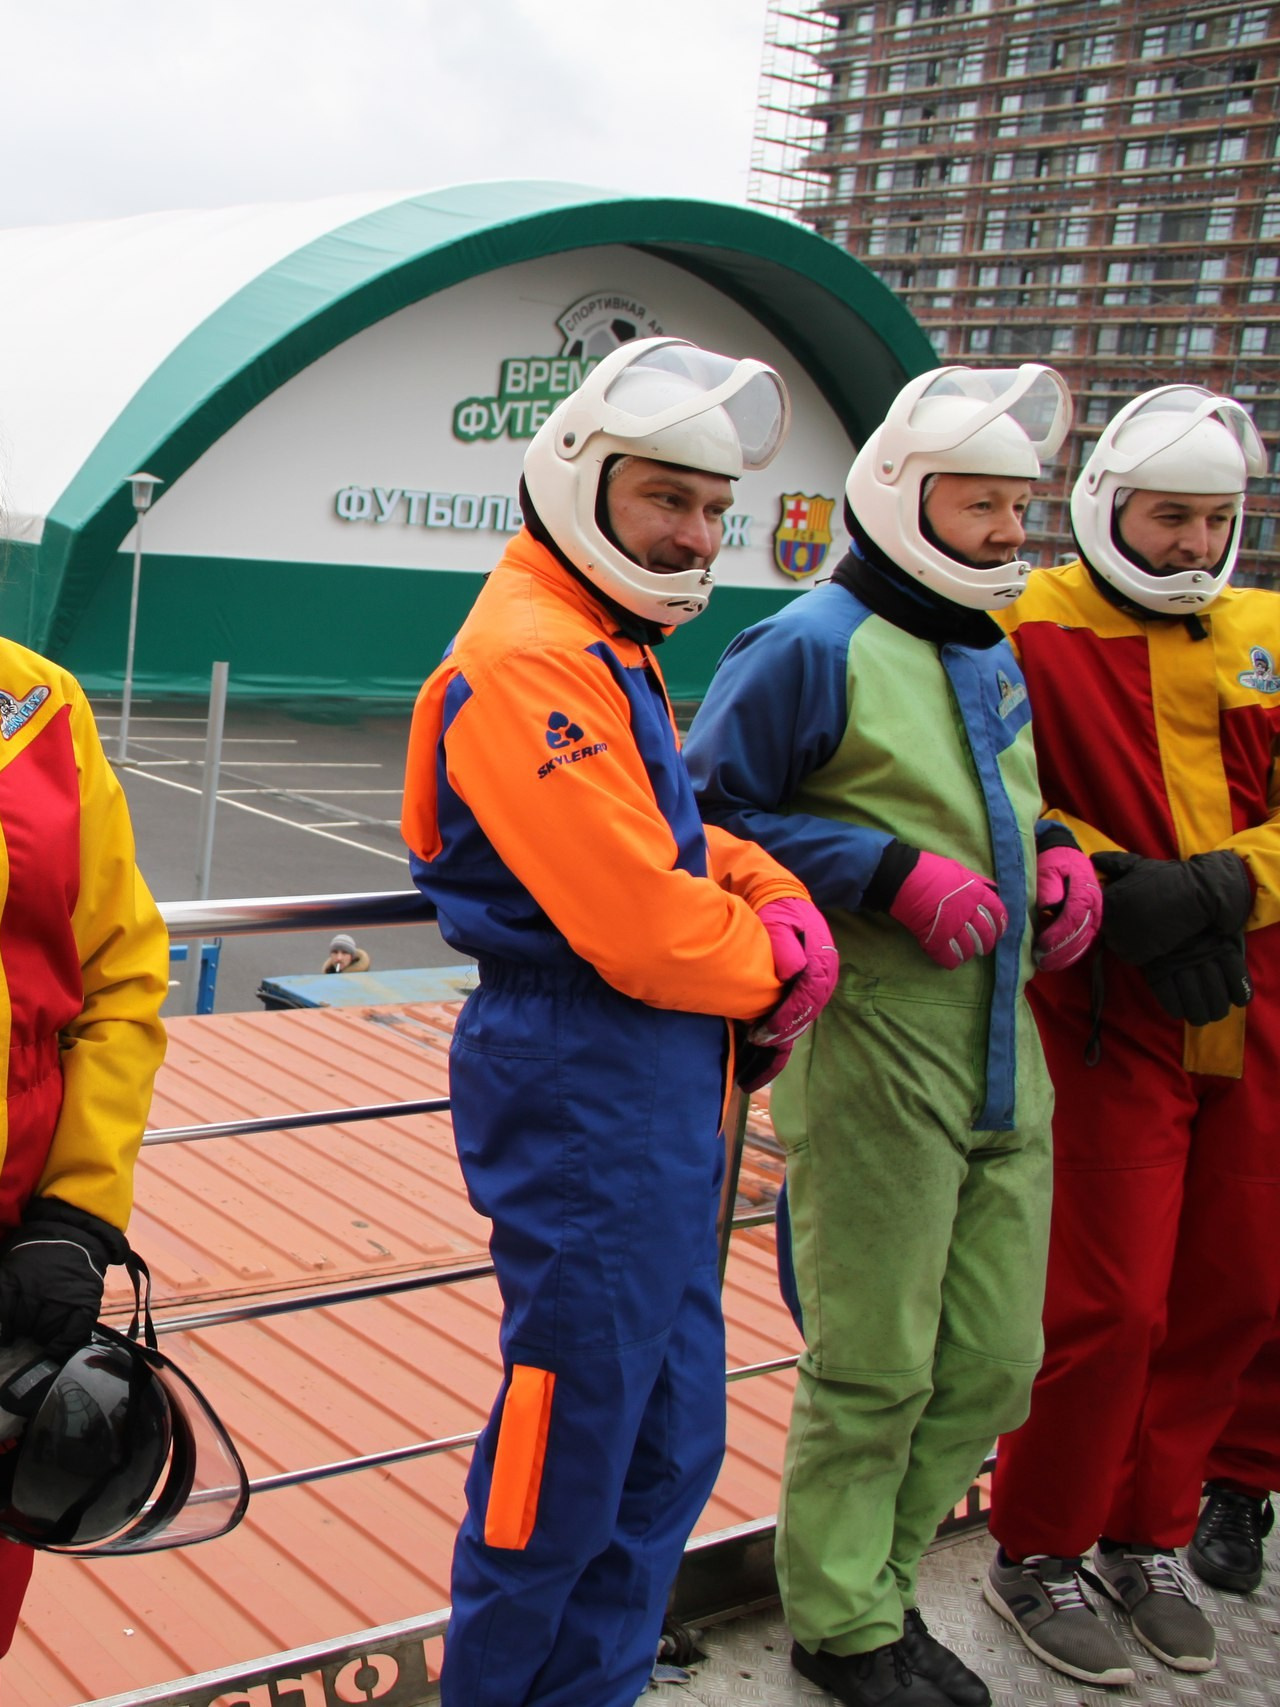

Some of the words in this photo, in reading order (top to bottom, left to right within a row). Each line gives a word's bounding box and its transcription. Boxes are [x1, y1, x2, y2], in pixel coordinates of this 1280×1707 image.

[565, 297, 647, 332] СПОРТИВНАЯ
[504, 360, 596, 394] ВРЕМ
[457, 400, 556, 436] ФУТБ
[336, 486, 524, 532] ФУТБОЛЬ
[20, 693, 41, 718] FLY
